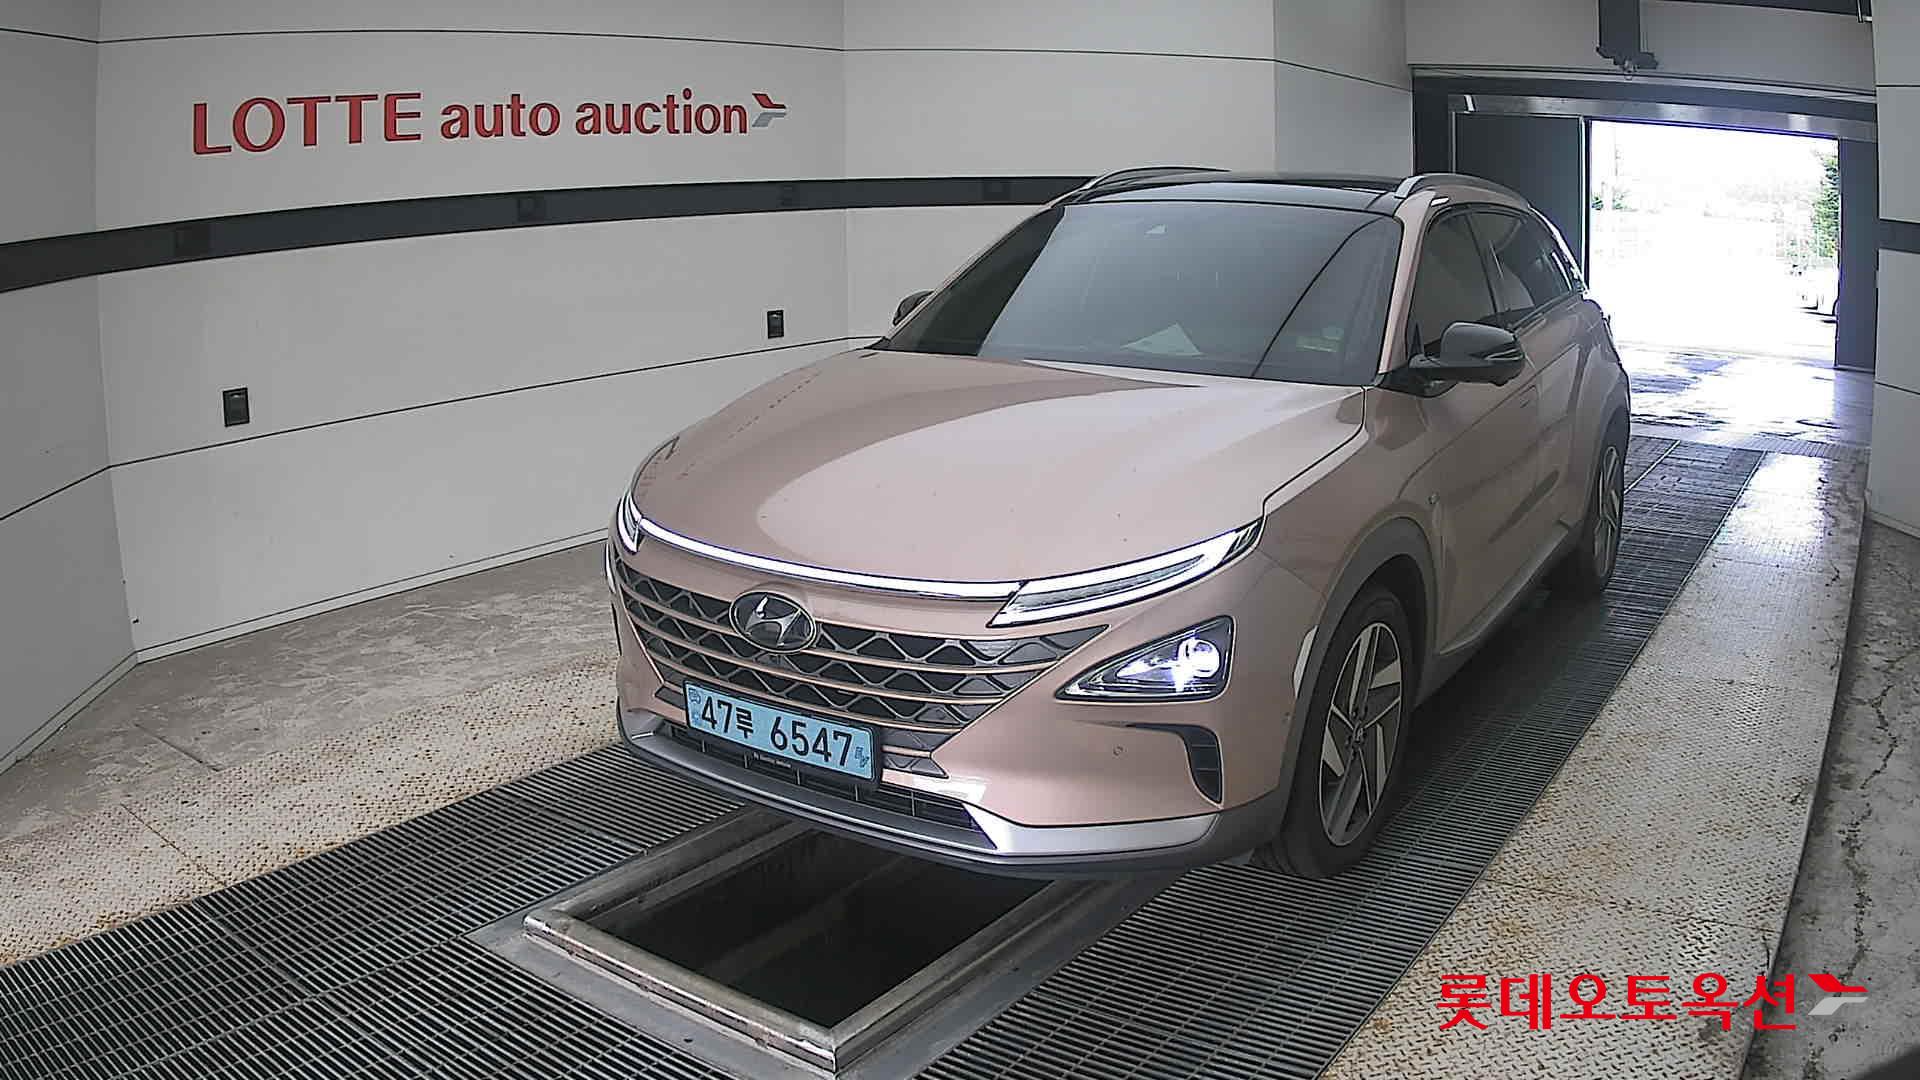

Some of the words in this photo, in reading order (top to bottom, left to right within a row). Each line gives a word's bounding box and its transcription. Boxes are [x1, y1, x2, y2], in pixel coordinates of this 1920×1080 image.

[192, 92, 422, 155] LOTTE
[440, 93, 561, 140] auto
[575, 88, 749, 135] auction
[701, 696, 754, 739] 47루
[770, 716, 853, 766] 6547
